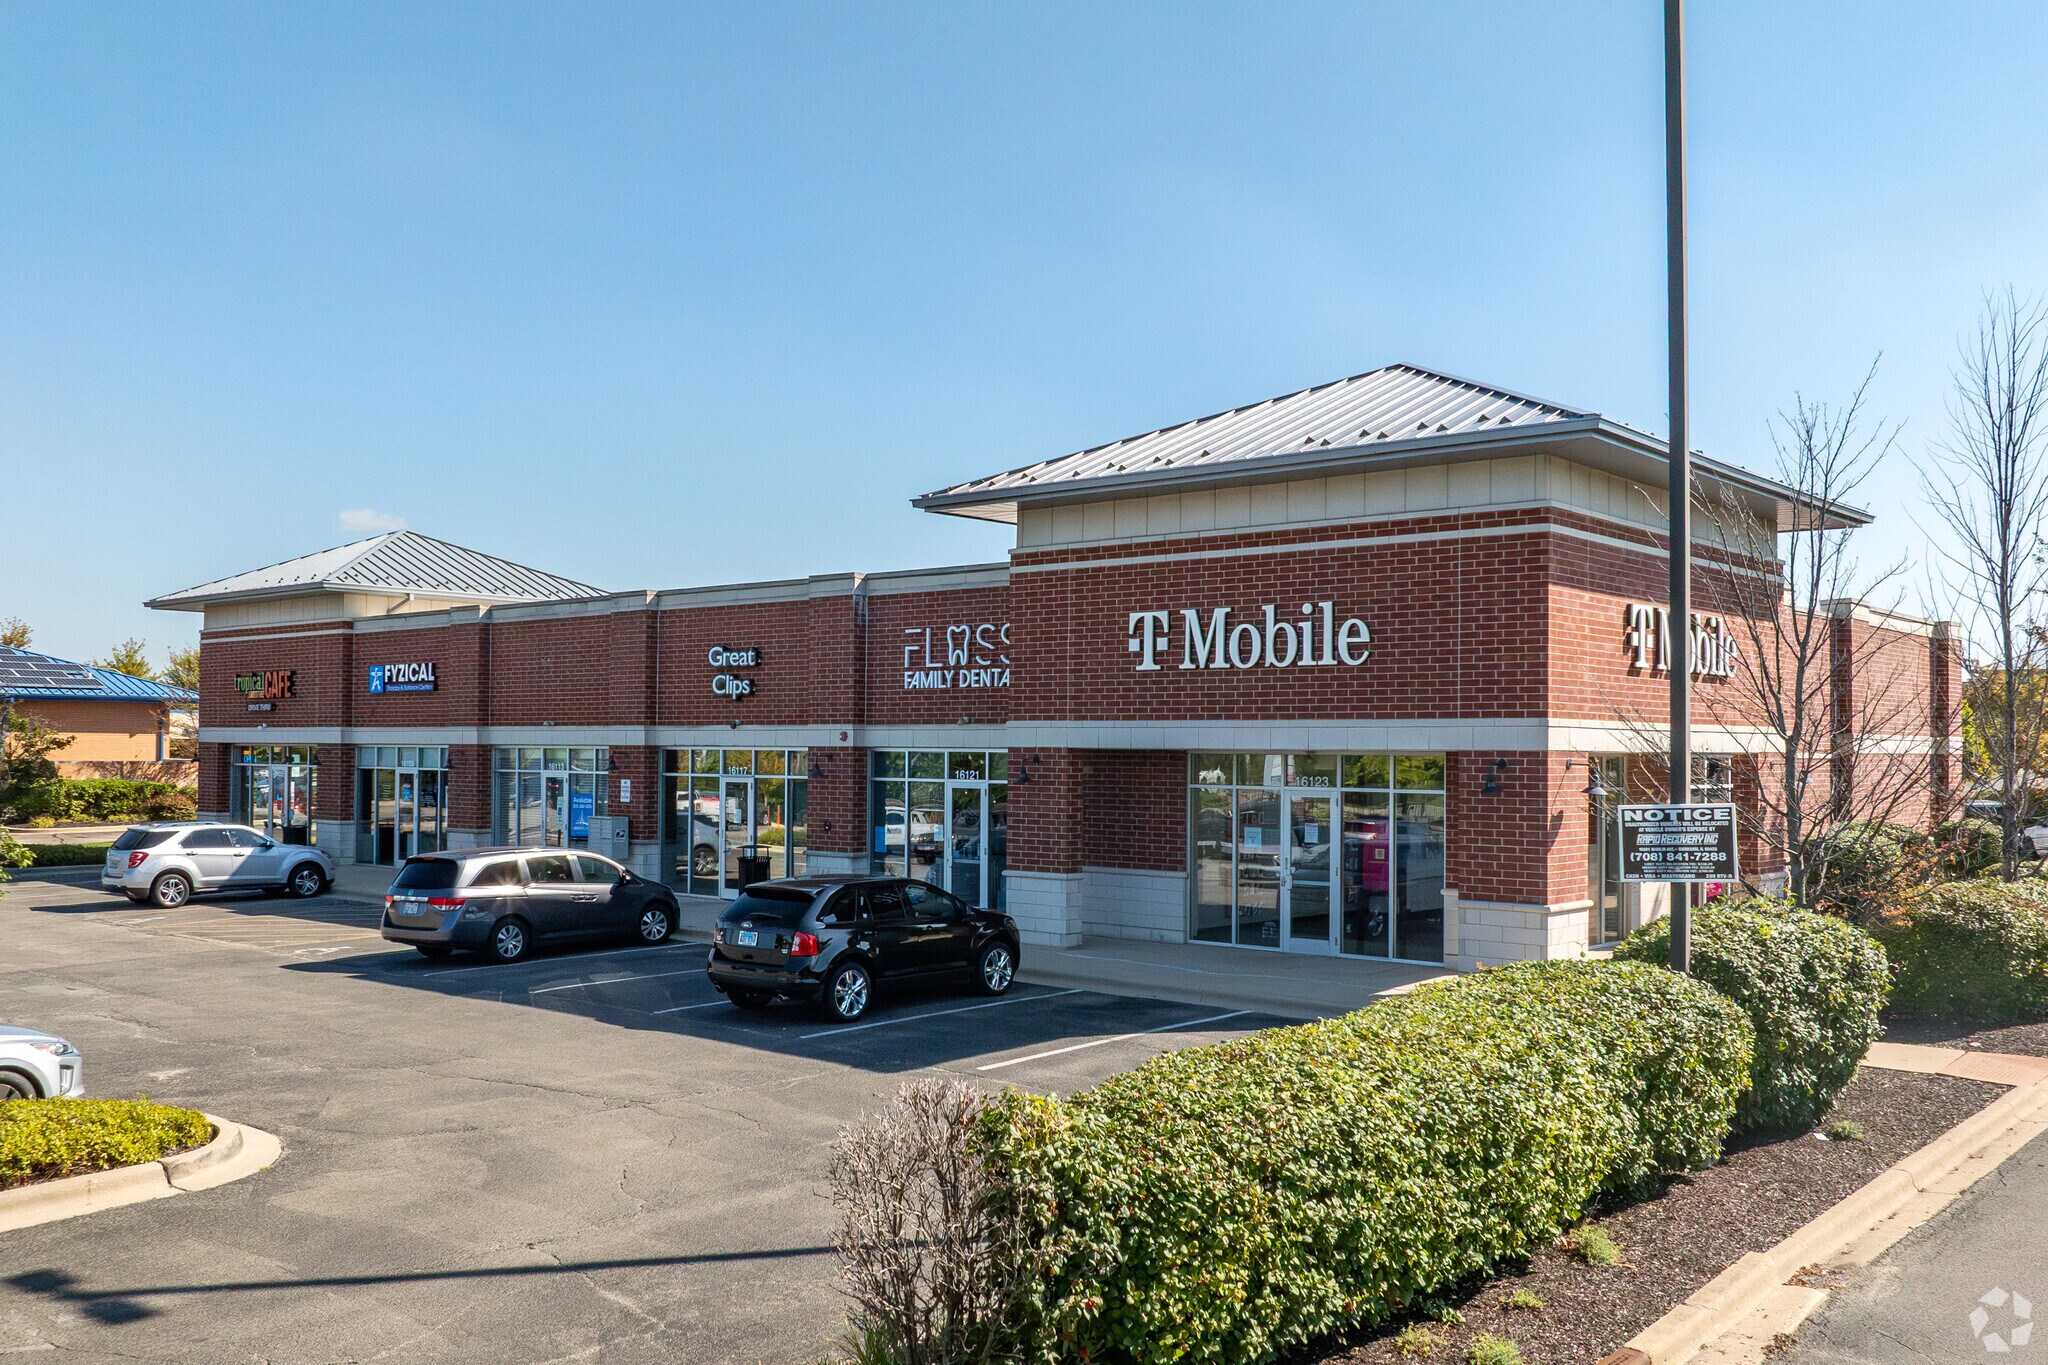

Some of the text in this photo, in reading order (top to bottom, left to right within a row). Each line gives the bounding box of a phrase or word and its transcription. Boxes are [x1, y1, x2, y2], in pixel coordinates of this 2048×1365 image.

[1179, 601, 1371, 669] Mobile
[708, 646, 756, 667] Great
[384, 662, 435, 683] FYZICAL
[234, 671, 291, 698] tropical CAFE
[904, 668, 1010, 690] FAMILY DENTA
[712, 674, 751, 699] Clips
[548, 762, 565, 771] 16113
[728, 766, 748, 775] 16117
[955, 770, 979, 780] 16121
[1295, 776, 1329, 787] 16123
[1624, 809, 1731, 821] NOTICE
[1637, 833, 1719, 845] RAPID RECOVERY INC
[1630, 852, 1727, 861] (708) 841-7288
